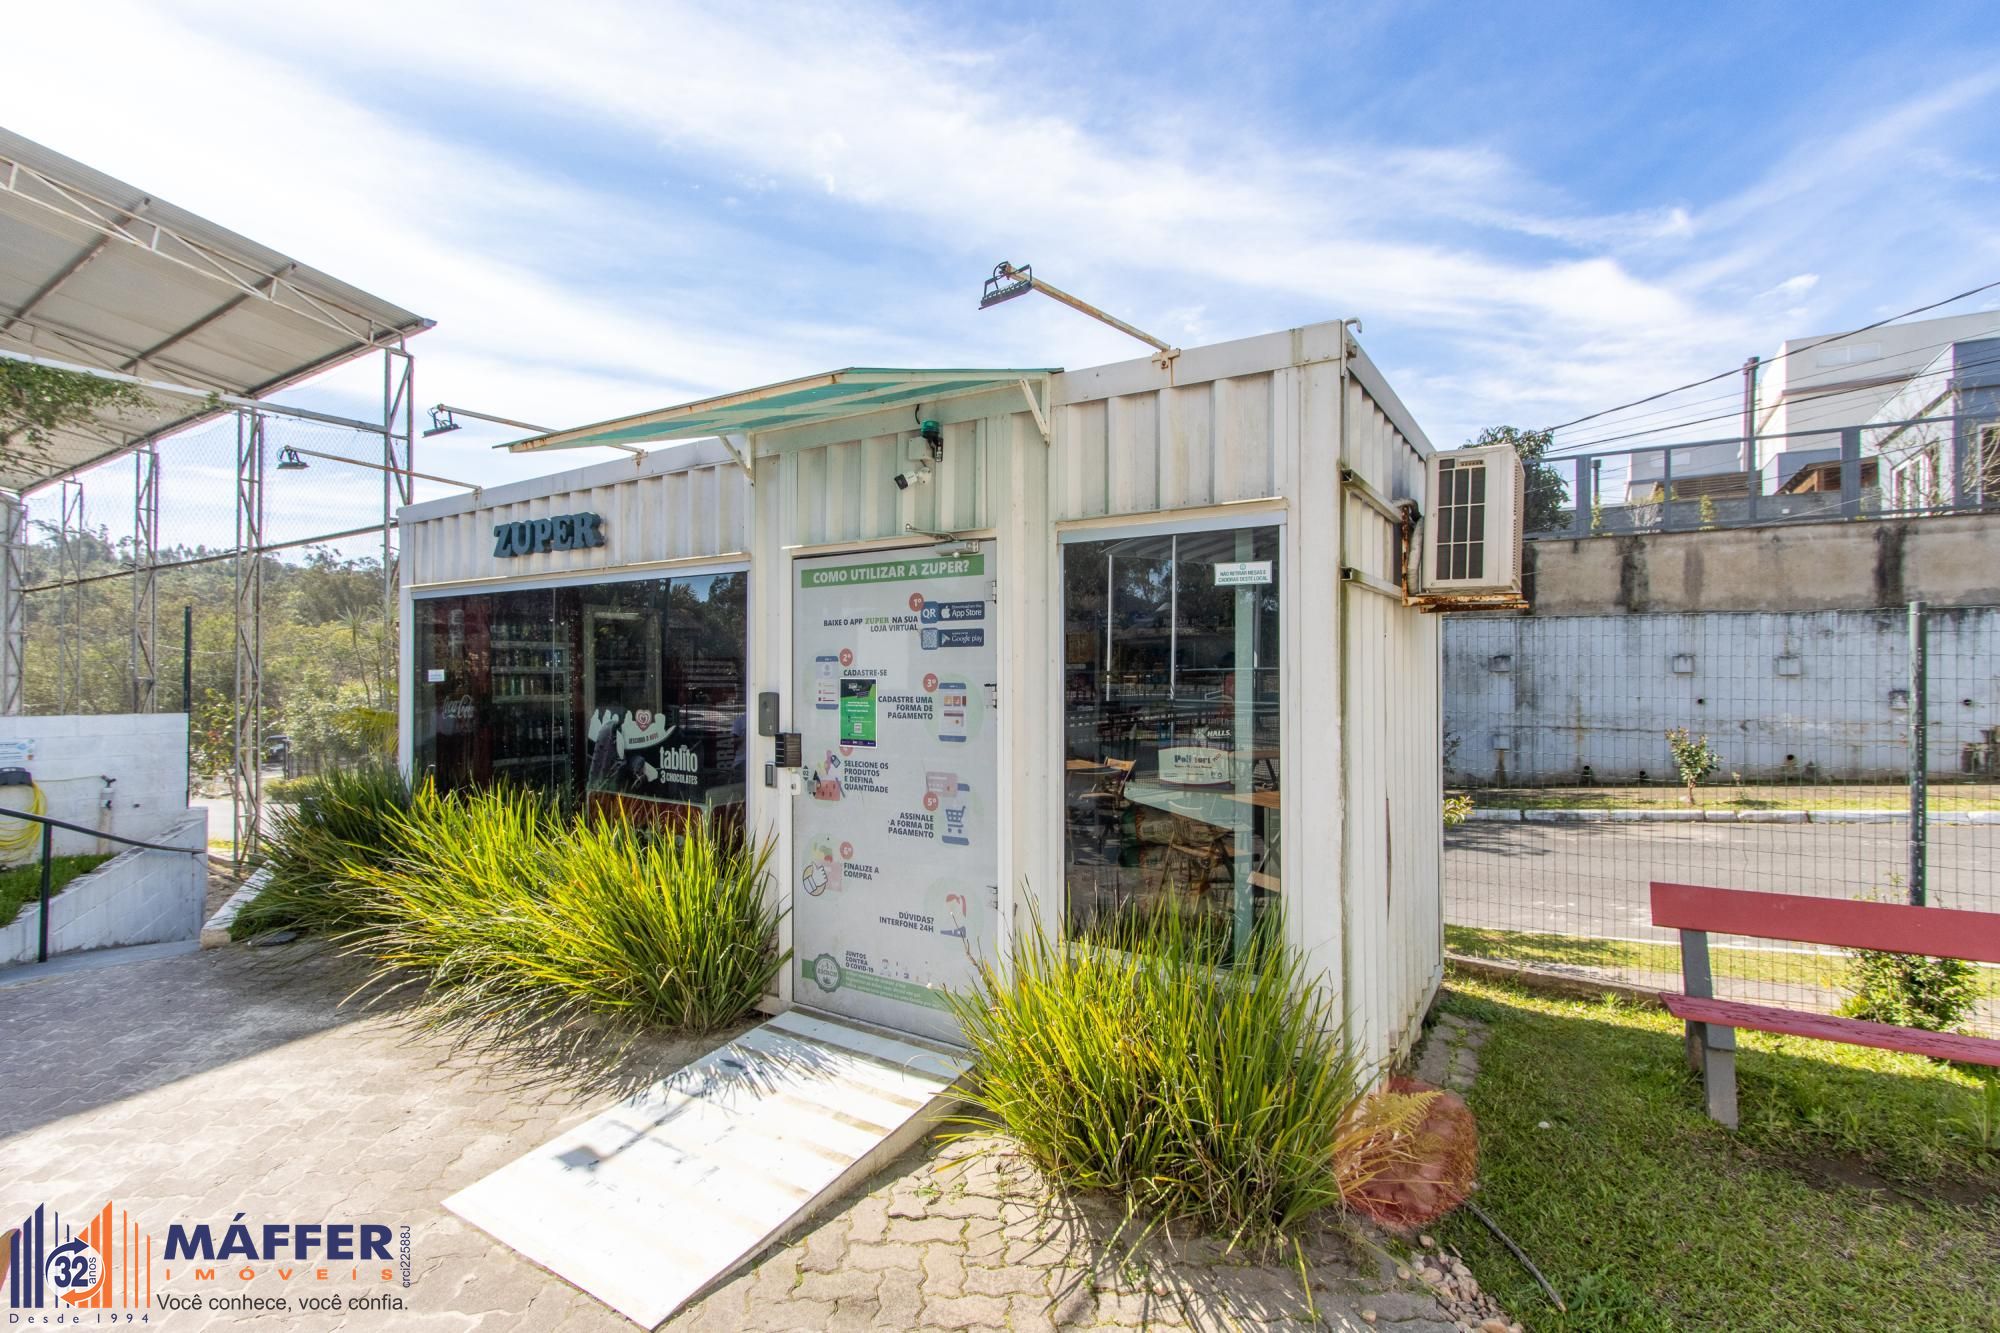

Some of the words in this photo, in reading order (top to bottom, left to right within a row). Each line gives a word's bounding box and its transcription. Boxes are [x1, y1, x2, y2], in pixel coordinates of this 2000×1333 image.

[493, 512, 605, 558] ZUPER
[813, 570, 848, 584] COMO
[851, 566, 905, 581] UTILIZAR
[908, 565, 918, 576] A
[921, 560, 970, 575] ZUPER?
[922, 608, 937, 619] QR
[952, 610, 965, 619] App
[965, 608, 982, 617] Store
[823, 619, 842, 627] BAIXE
[843, 618, 849, 626] O
[849, 618, 863, 626] APP
[864, 617, 890, 625] ZUPER
[892, 616, 903, 624] NA
[904, 615, 919, 623] SUA
[870, 625, 887, 633] LOJA
[888, 624, 919, 632] VIRTUAL
[951, 635, 970, 644] Google
[971, 635, 983, 643] play
[843, 669, 888, 677] CADASTRE-SE
[878, 695, 914, 704] CADASTRE
[915, 696, 933, 704] UMA
[896, 704, 922, 712] FORMA
[924, 704, 934, 712] DE
[887, 712, 934, 720] PAGAMENTO
[844, 760, 878, 769] SELECIONE
[660, 770, 666, 784] 3
[666, 772, 698, 785] CHOCOLATES
[844, 768, 880, 777] PRODUTOS
[849, 776, 874, 785] DEFINA
[844, 783, 889, 793] QUANTIDADE
[900, 812, 934, 822] ASSINALE
[897, 820, 923, 829] FORMA
[924, 822, 934, 830] DE
[888, 827, 934, 838] PAGAMENTO
[843, 862, 873, 873] FINALIZE
[874, 866, 880, 874] A
[843, 870, 872, 880] COMPRA
[898, 910, 935, 925] DÚVIDAS?
[879, 916, 918, 930] INTERFONE
[919, 924, 934, 933] 24H
[845, 950, 867, 959] JUNTOS
[845, 956, 868, 966] CONTRA
[850, 963, 874, 974] COVID-19
